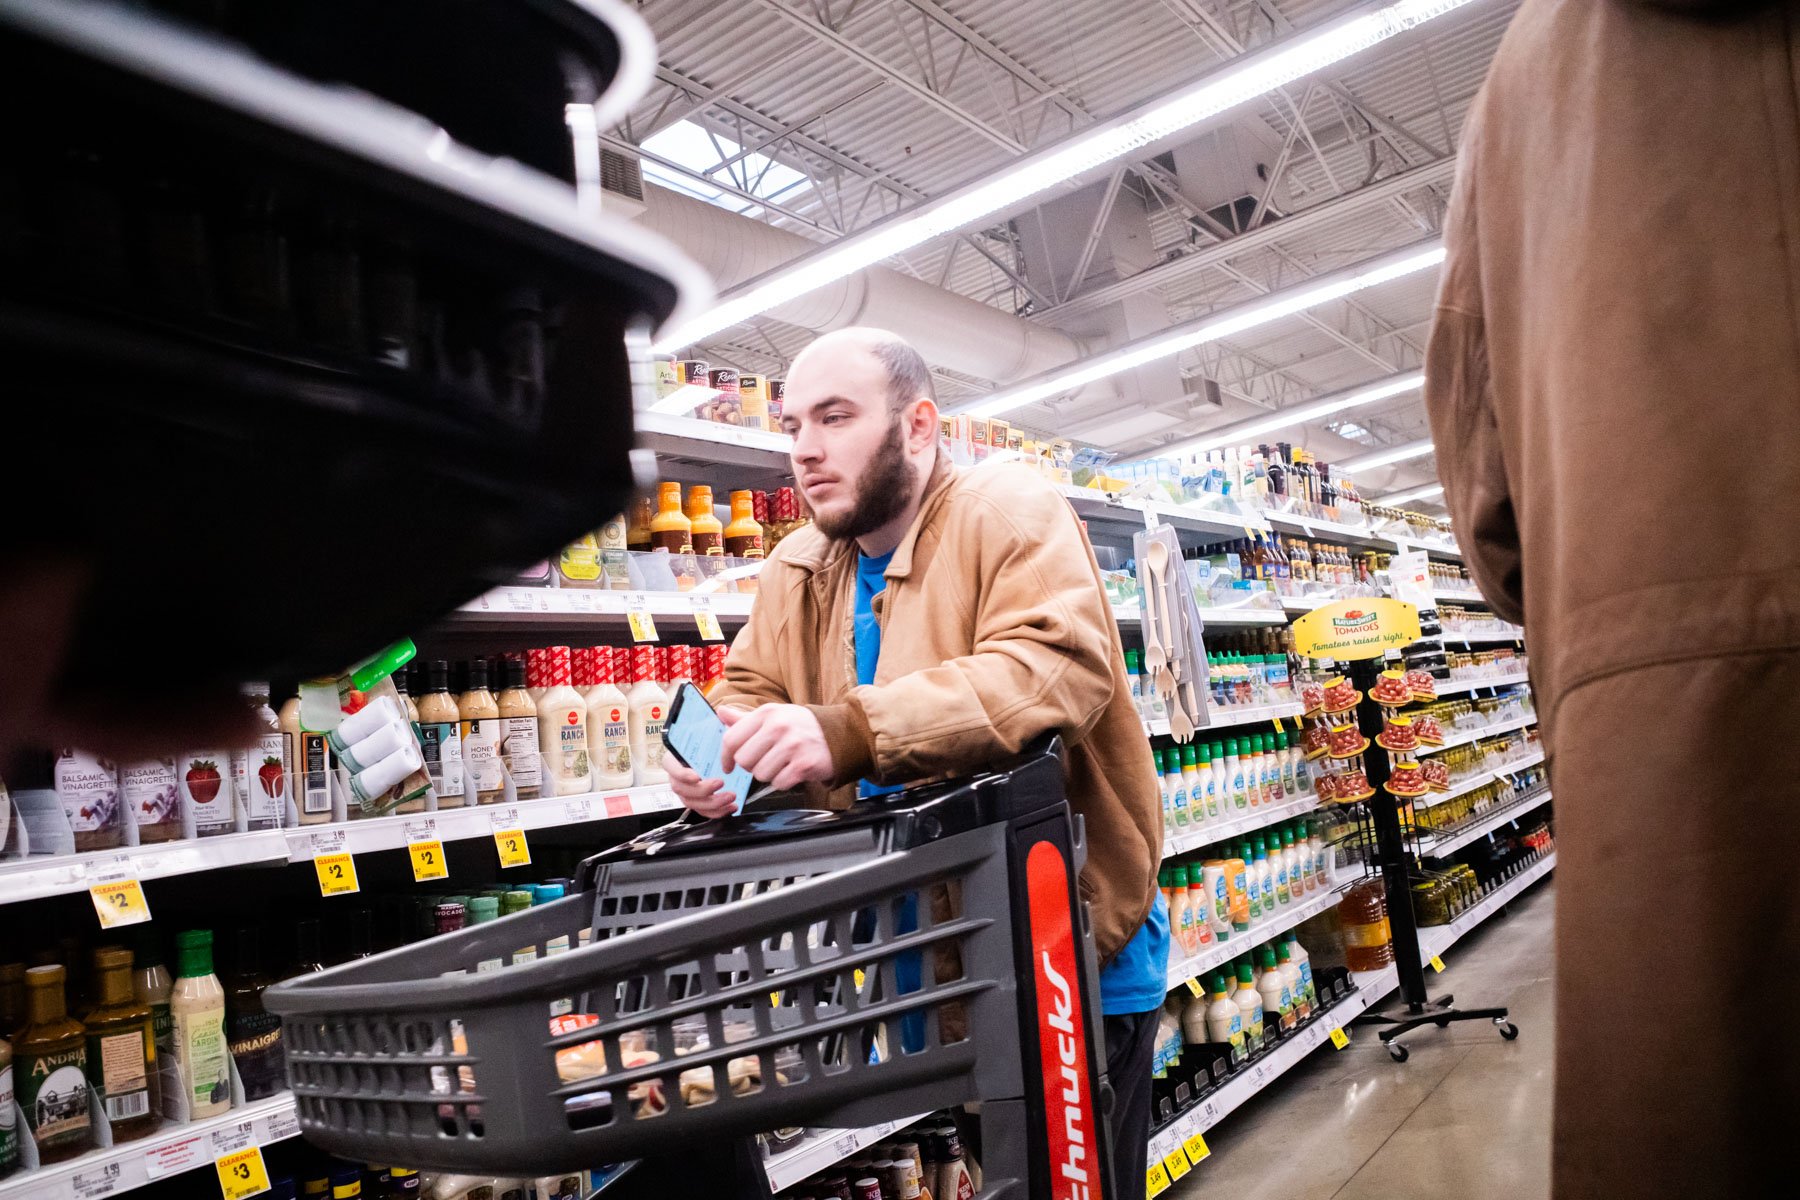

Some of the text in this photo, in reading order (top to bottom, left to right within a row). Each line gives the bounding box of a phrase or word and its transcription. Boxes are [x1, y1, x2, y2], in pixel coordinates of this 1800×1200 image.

[1334, 621, 1379, 636] TOMATOES
[1312, 641, 1351, 652] Tomatoes
[1353, 635, 1380, 646] raised
[561, 729, 584, 741] RANCH
[604, 726, 626, 738] RANCH
[62, 773, 104, 783] BALSAMIC
[123, 768, 164, 779] BALSAMIC
[125, 774, 176, 786] VINAIGRETTE
[62, 779, 116, 790] VINAIGRETTE
[496, 832, 523, 840] CLEARANCE
[411, 843, 440, 852] CLEARANCE
[505, 839, 518, 852] $2
[317, 856, 350, 865] CLEARANCE
[421, 851, 434, 865] $2
[329, 864, 344, 879] $2
[93, 882, 137, 895] CLEARANCE
[109, 893, 129, 908] $2
[1042, 950, 1090, 1200] chnucks
[219, 1150, 259, 1168] CLEARANCE
[233, 1162, 251, 1179] $3
